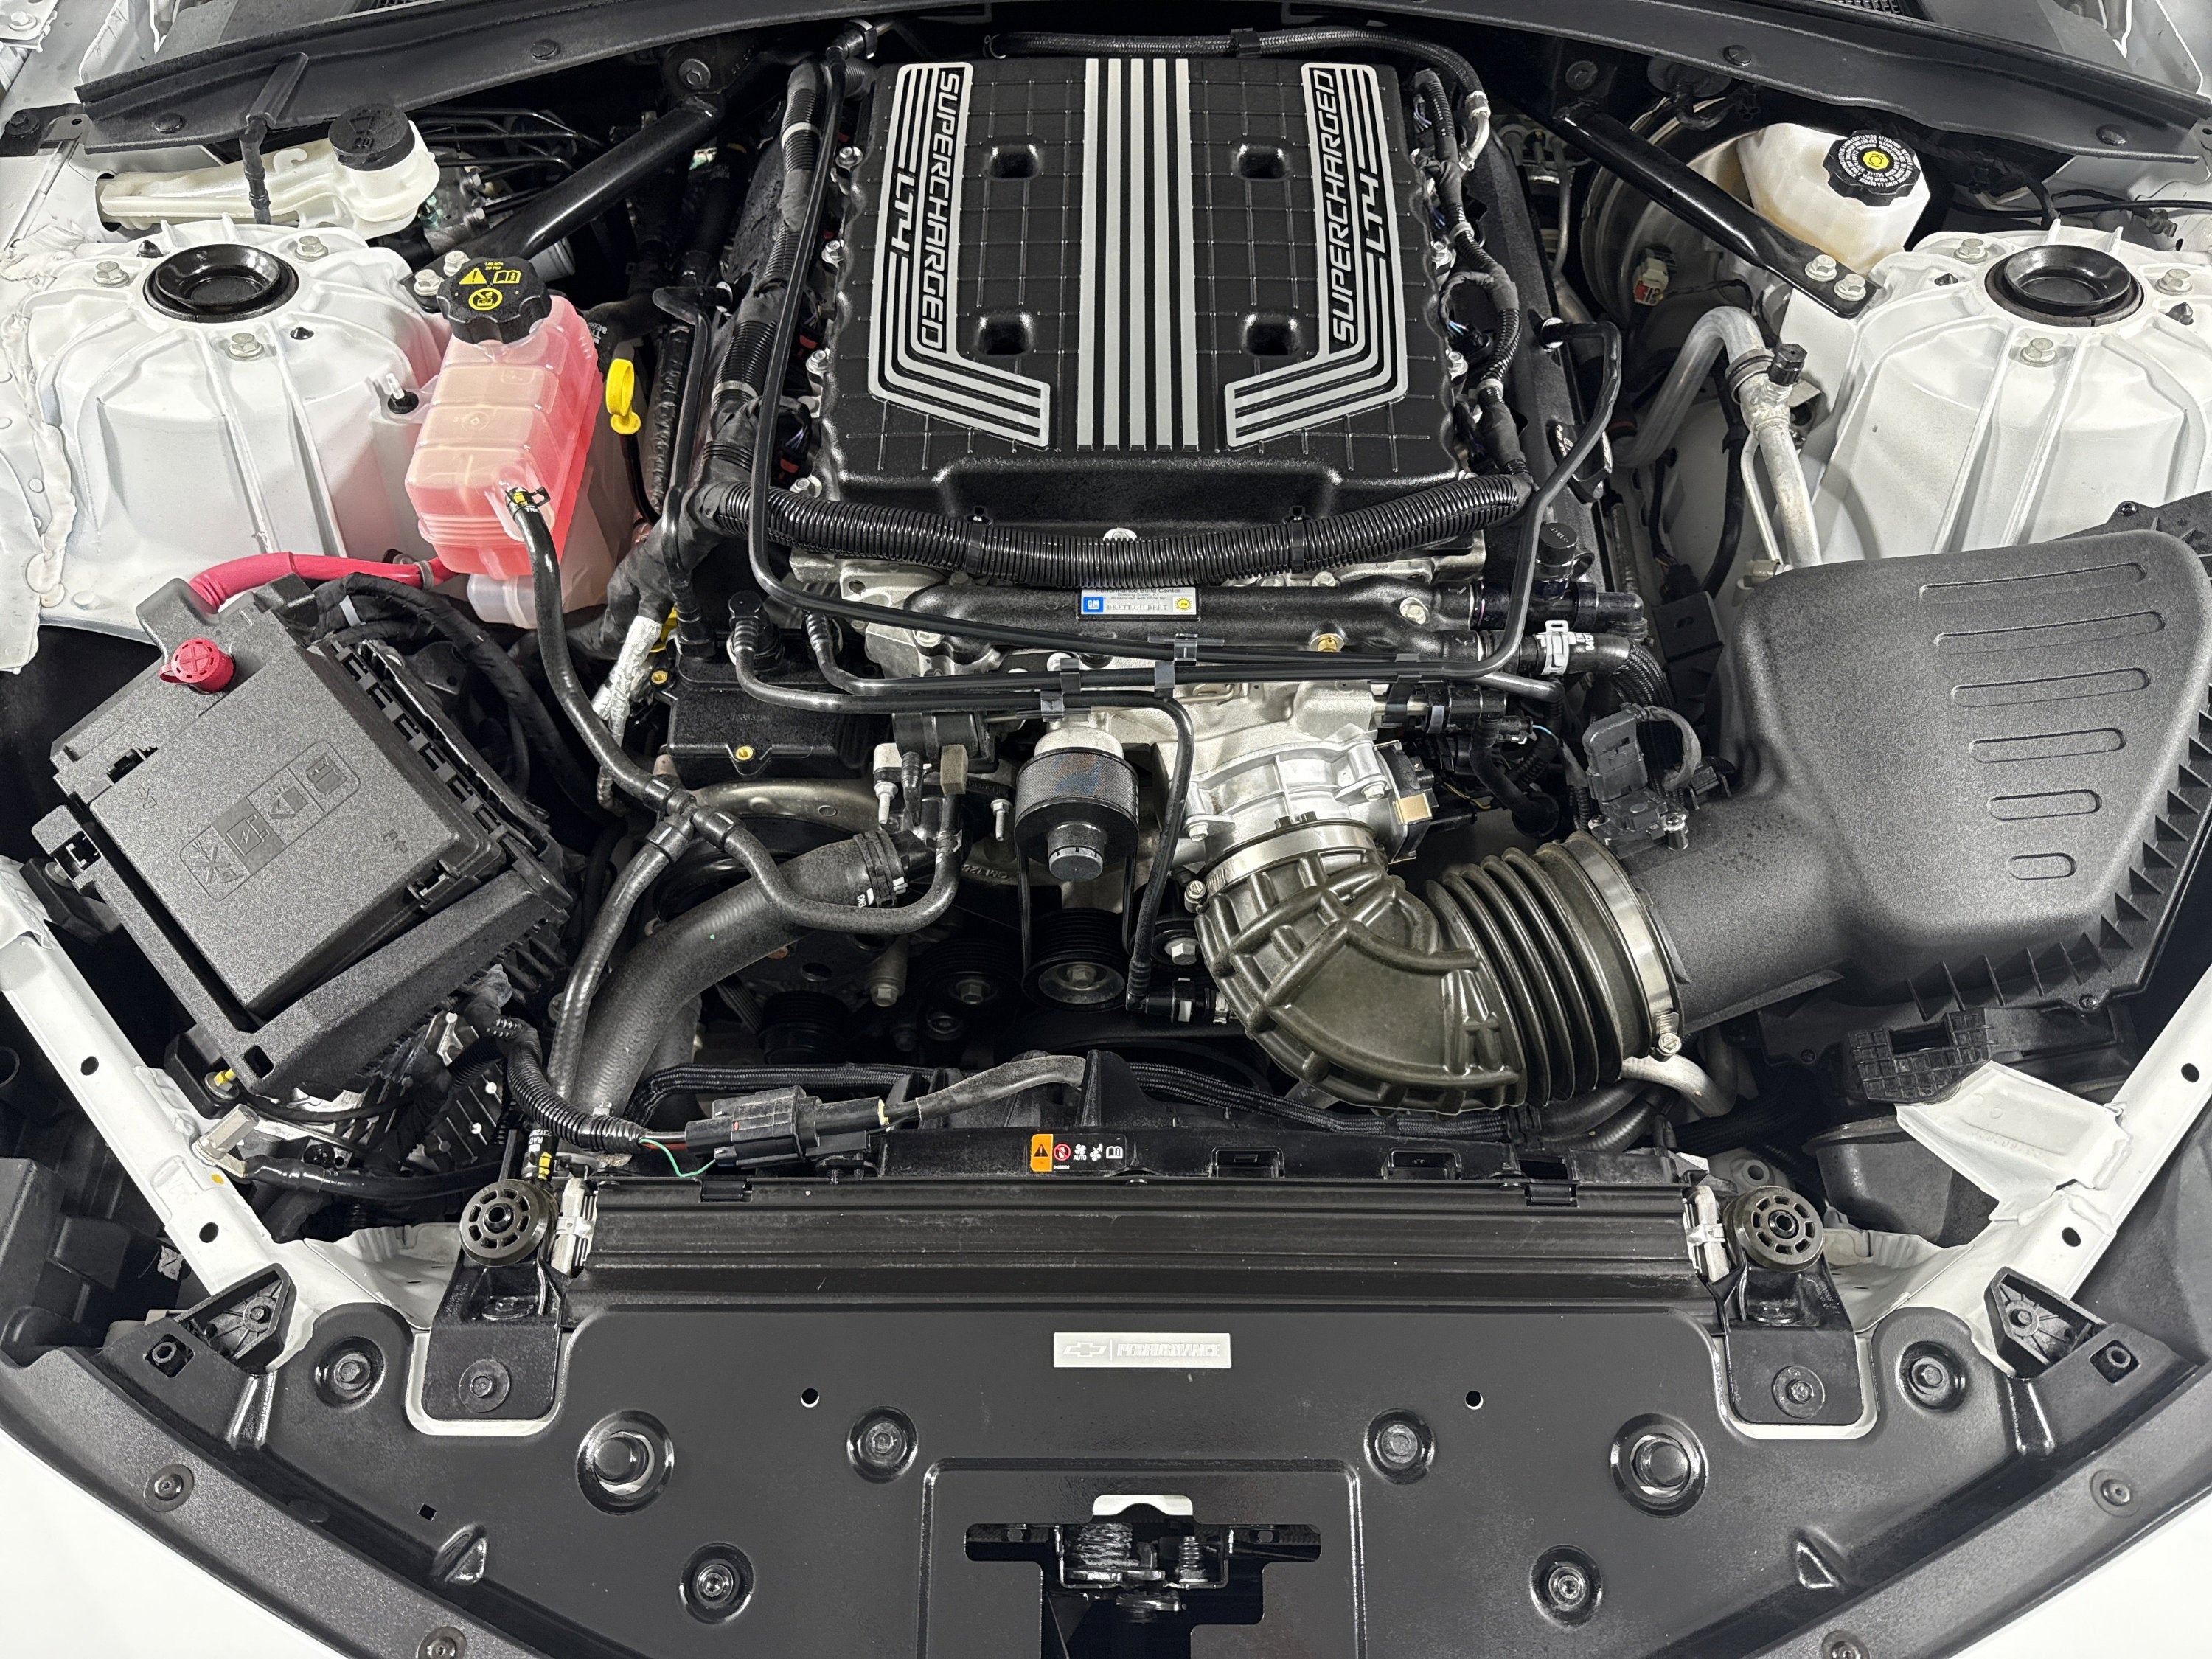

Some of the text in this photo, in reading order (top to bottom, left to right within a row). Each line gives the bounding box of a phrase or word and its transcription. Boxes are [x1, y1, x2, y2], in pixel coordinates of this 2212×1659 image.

[891, 165, 915, 252] LT4
[920, 70, 960, 351] SUPERCHARGED
[1312, 69, 1356, 344] SUPERCHARGED
[1357, 173, 1385, 254] LT4
[1088, 599, 1099, 609] GM
[529, 1136, 543, 1144] RAD
